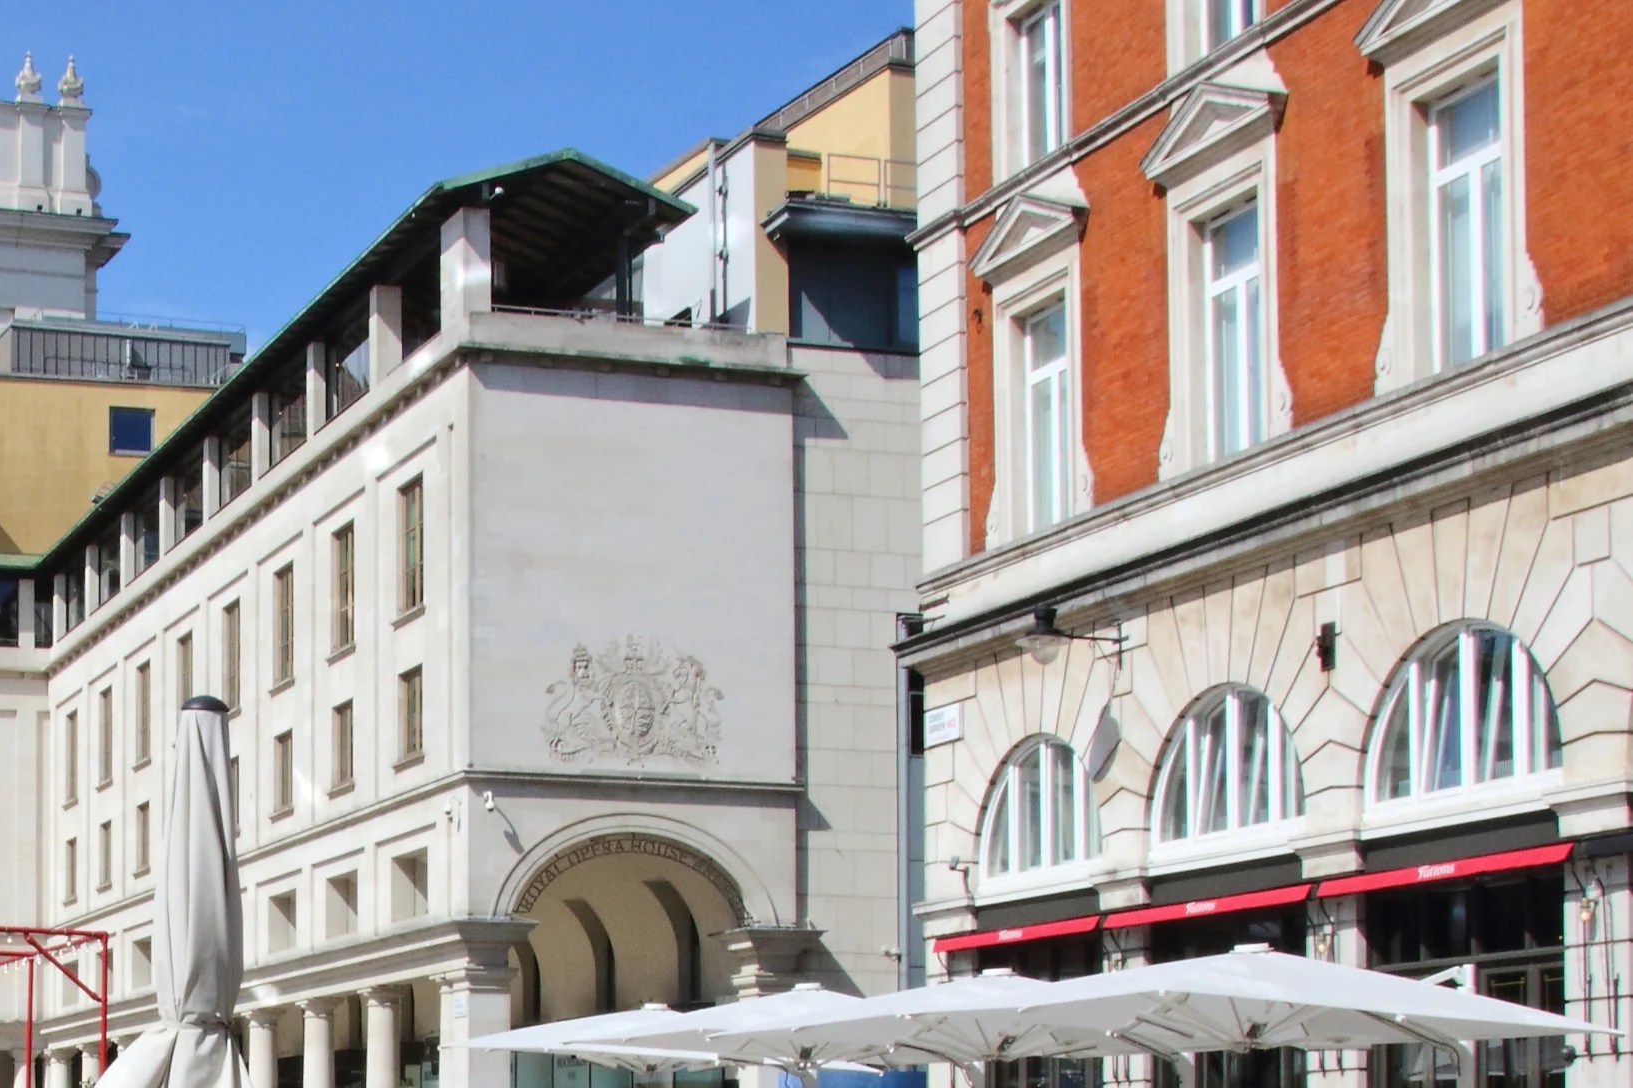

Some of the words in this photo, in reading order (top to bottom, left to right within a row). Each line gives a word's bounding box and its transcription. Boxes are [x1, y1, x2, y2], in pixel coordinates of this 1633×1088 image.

[514, 856, 565, 913] ROYAL
[567, 838, 625, 866] OPERA
[631, 839, 692, 868] HOUSE
[1417, 863, 1455, 881] Tuttons
